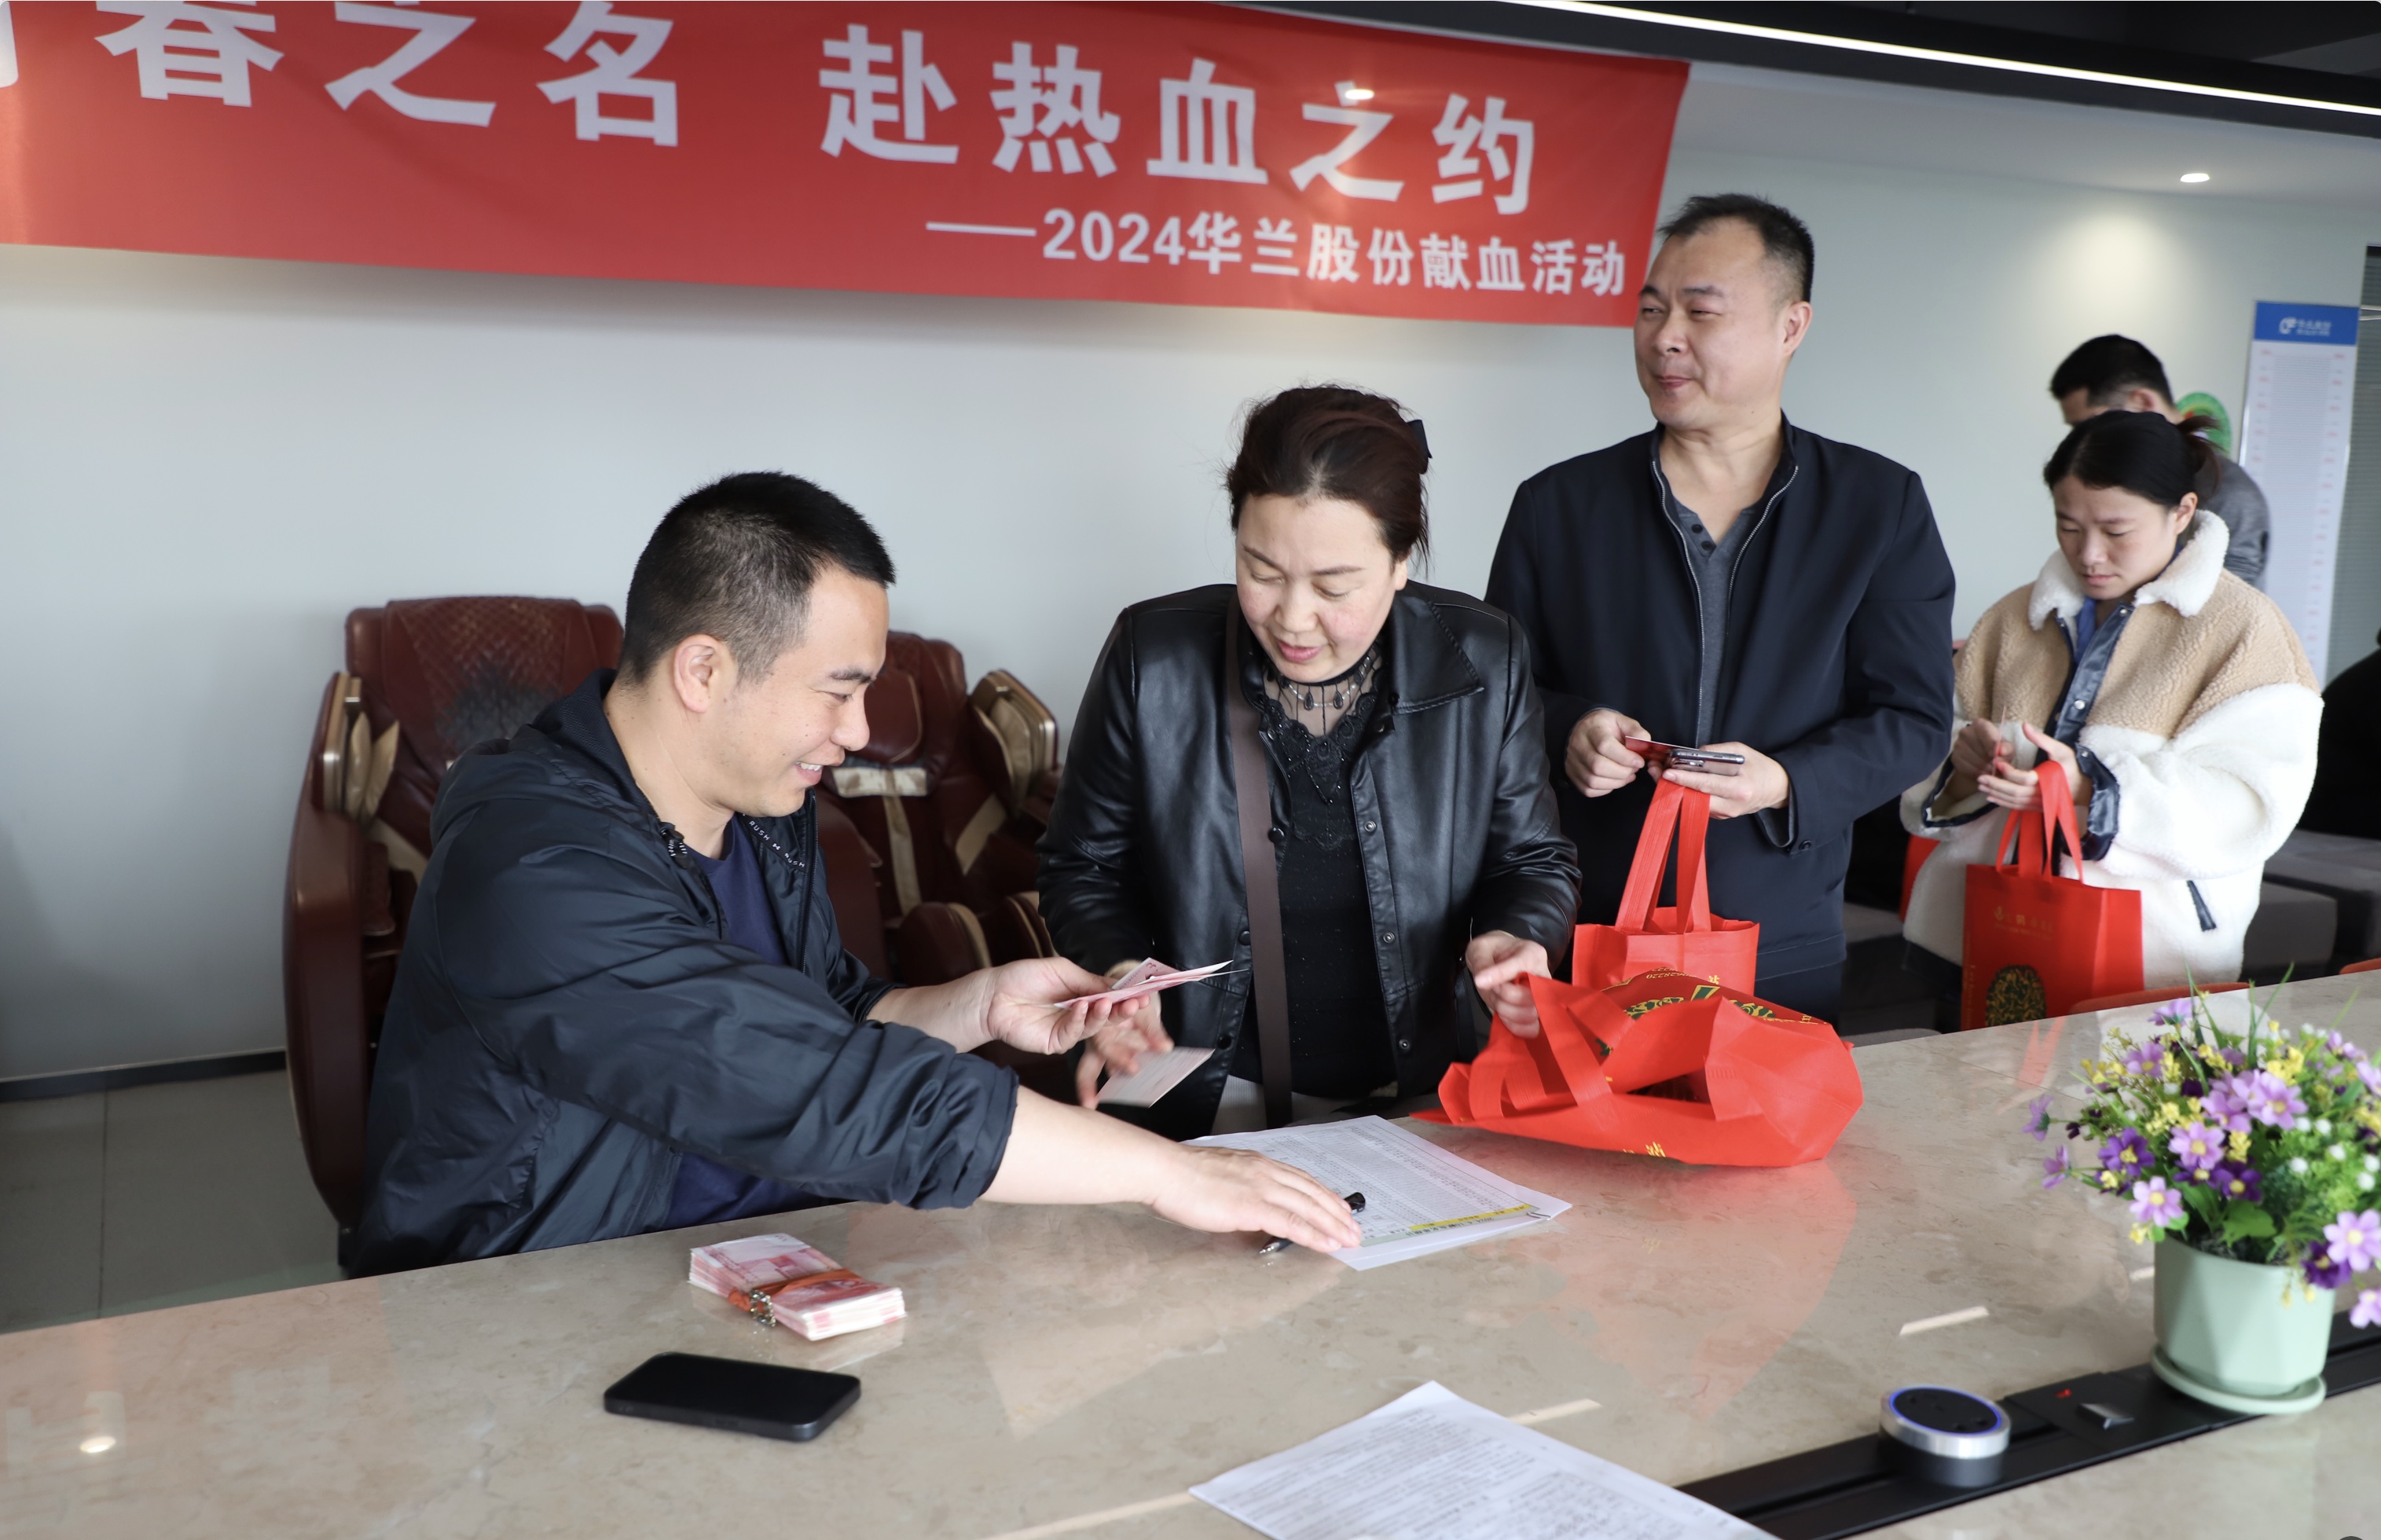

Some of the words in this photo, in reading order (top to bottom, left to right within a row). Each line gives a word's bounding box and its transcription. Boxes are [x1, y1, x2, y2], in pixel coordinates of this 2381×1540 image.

[0, 0, 680, 147] 春之名
[820, 24, 1535, 216] 赴热血之约
[749, 820, 770, 841] RUSH
[784, 852, 805, 868] RUSH
